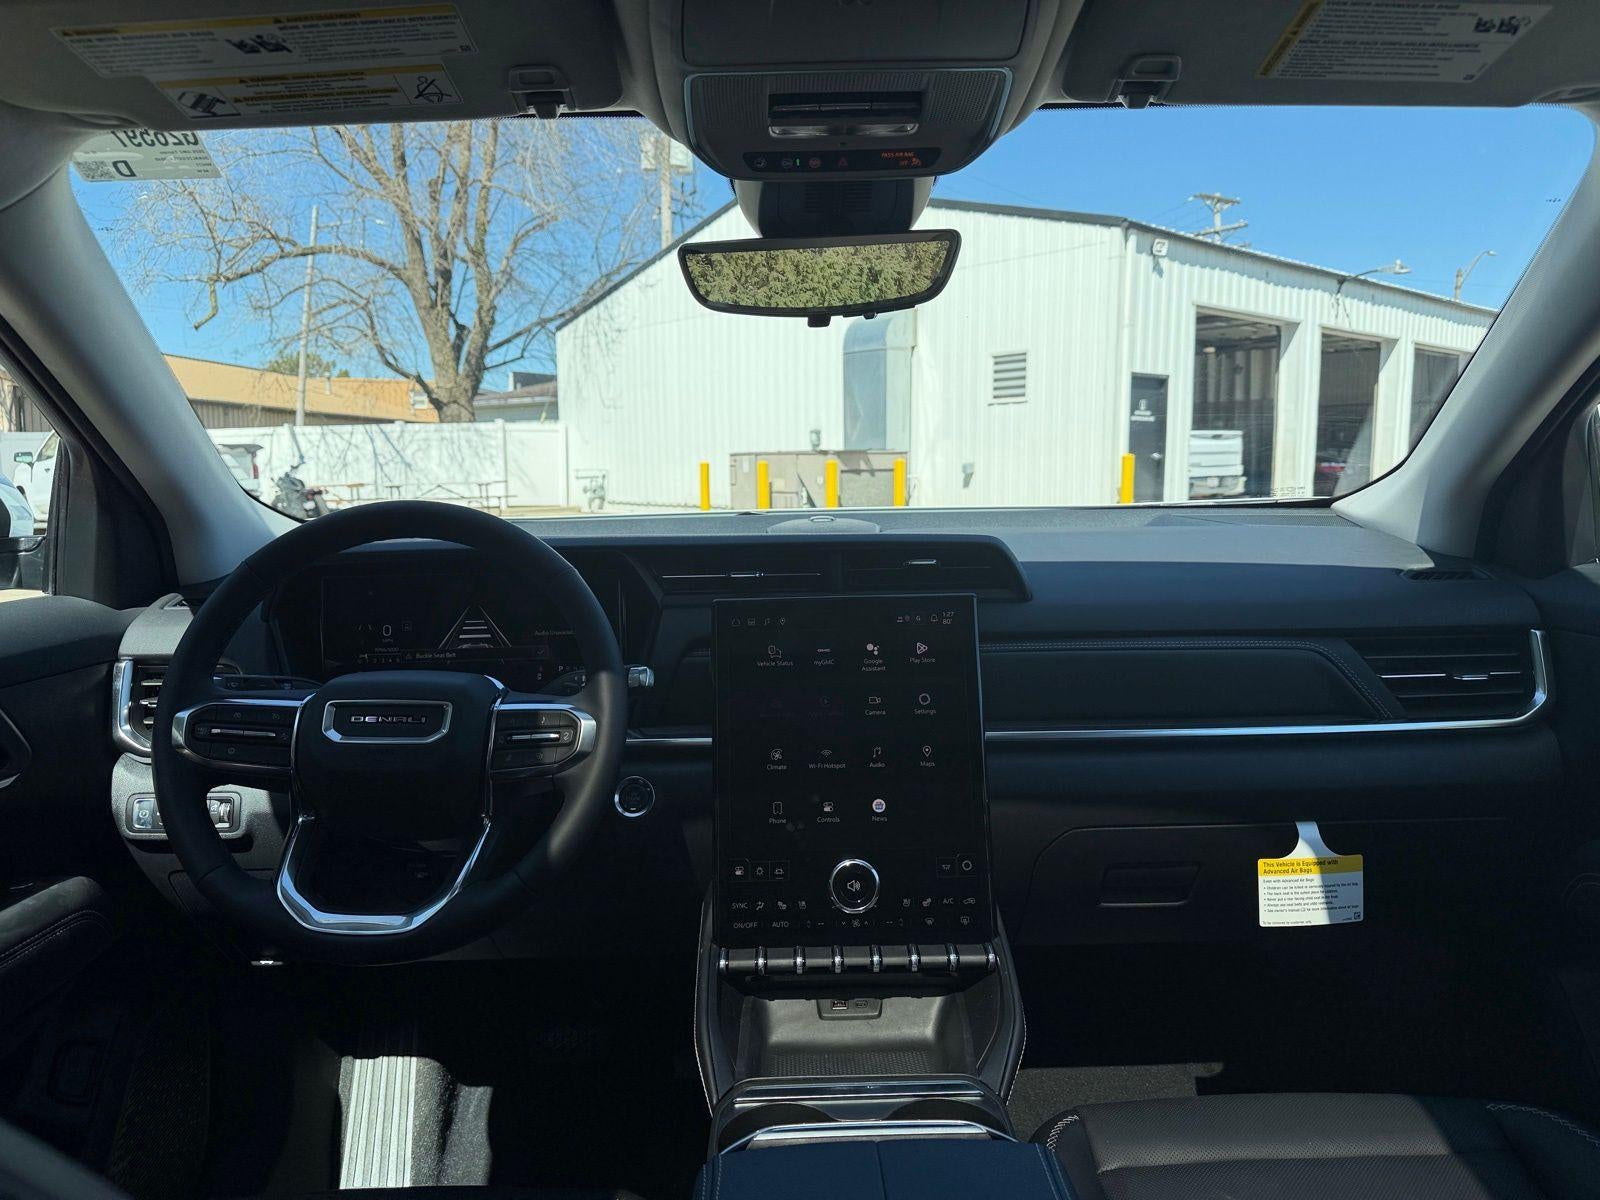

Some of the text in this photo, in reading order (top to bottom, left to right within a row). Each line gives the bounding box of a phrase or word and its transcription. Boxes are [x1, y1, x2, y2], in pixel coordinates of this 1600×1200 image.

[350, 715, 427, 723] DENALI
[768, 816, 787, 824] Phone
[816, 816, 841, 824] Controls
[731, 902, 748, 910] SYNC
[732, 921, 759, 929] ON/OFF
